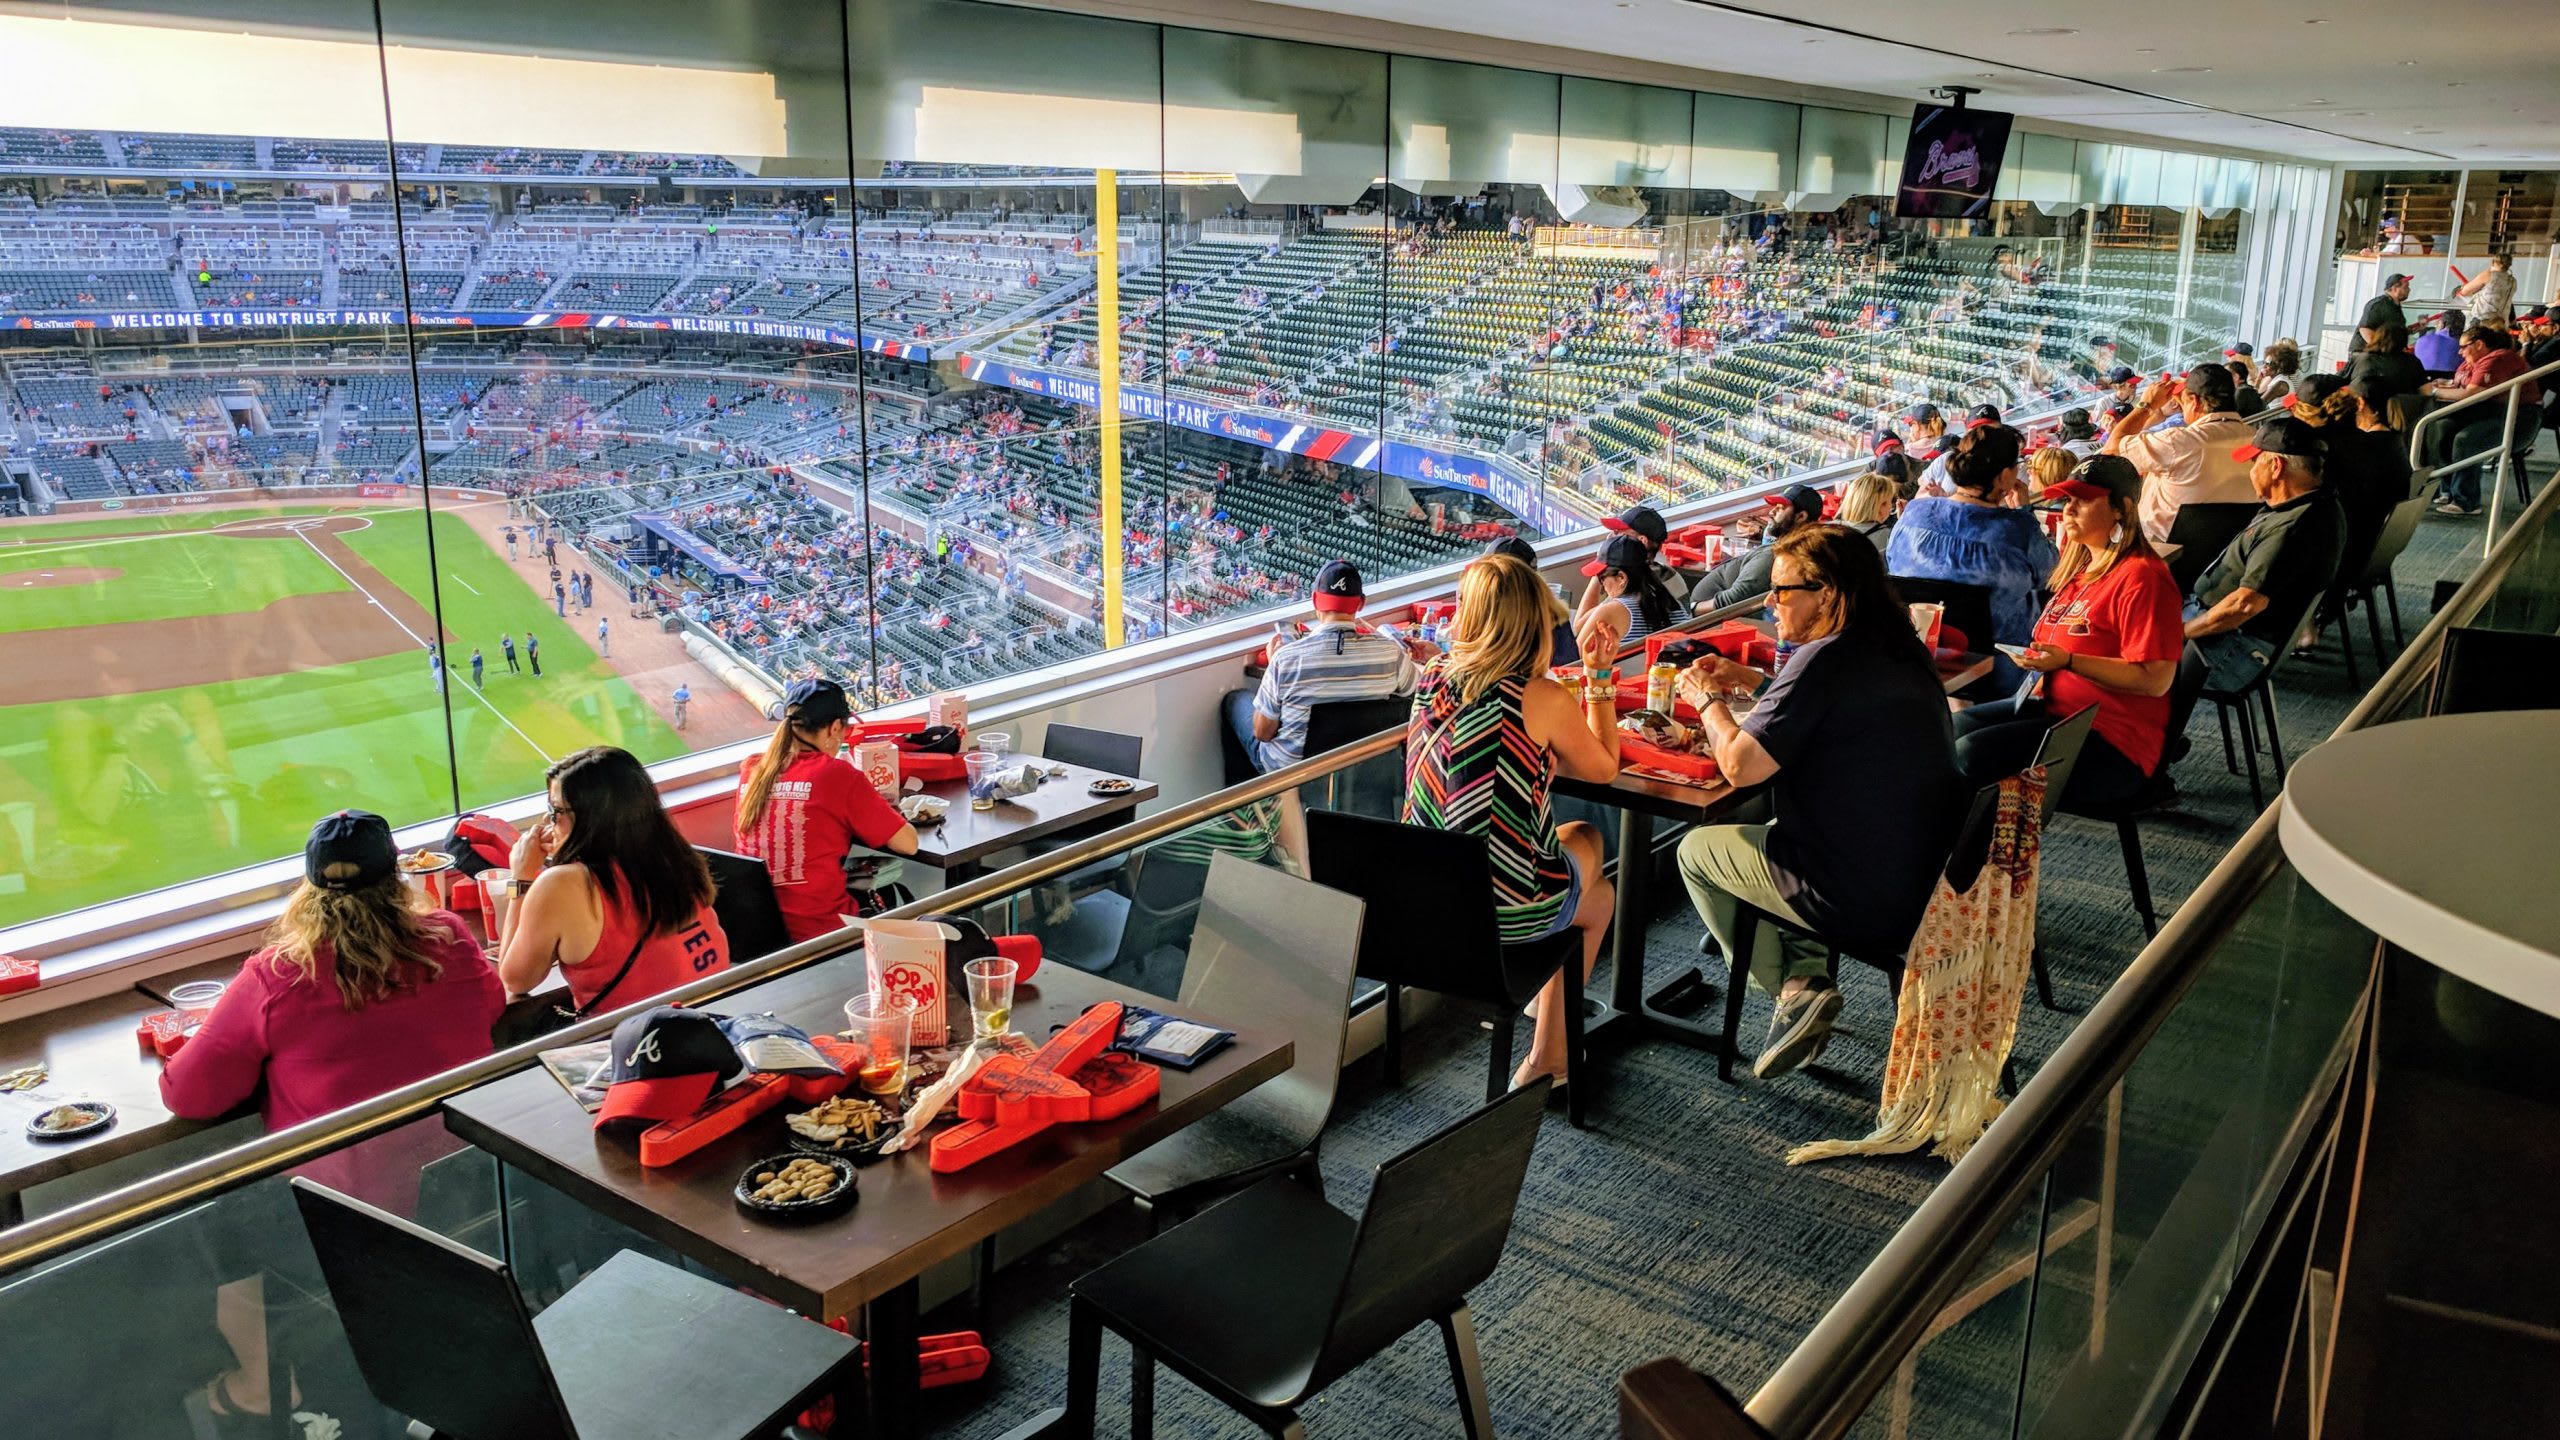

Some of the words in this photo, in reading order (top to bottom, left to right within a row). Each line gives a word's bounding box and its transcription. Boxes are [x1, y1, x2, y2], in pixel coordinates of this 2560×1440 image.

[111, 313, 203, 328] WELCOME
[211, 313, 234, 325] TO
[242, 312, 337, 325] SUNTRUST
[345, 312, 392, 324] PARK
[672, 318, 730, 332] WELCOME
[733, 321, 749, 334] TO
[754, 322, 803, 338] SUNTRUST
[805, 327, 827, 342] PARK
[1048, 377, 1095, 403] WELCOME
[1178, 404, 1209, 429] PARK
[1489, 471, 1529, 517] WELCOME
[793, 781, 813, 793] NLC
[884, 967, 921, 992] POP
